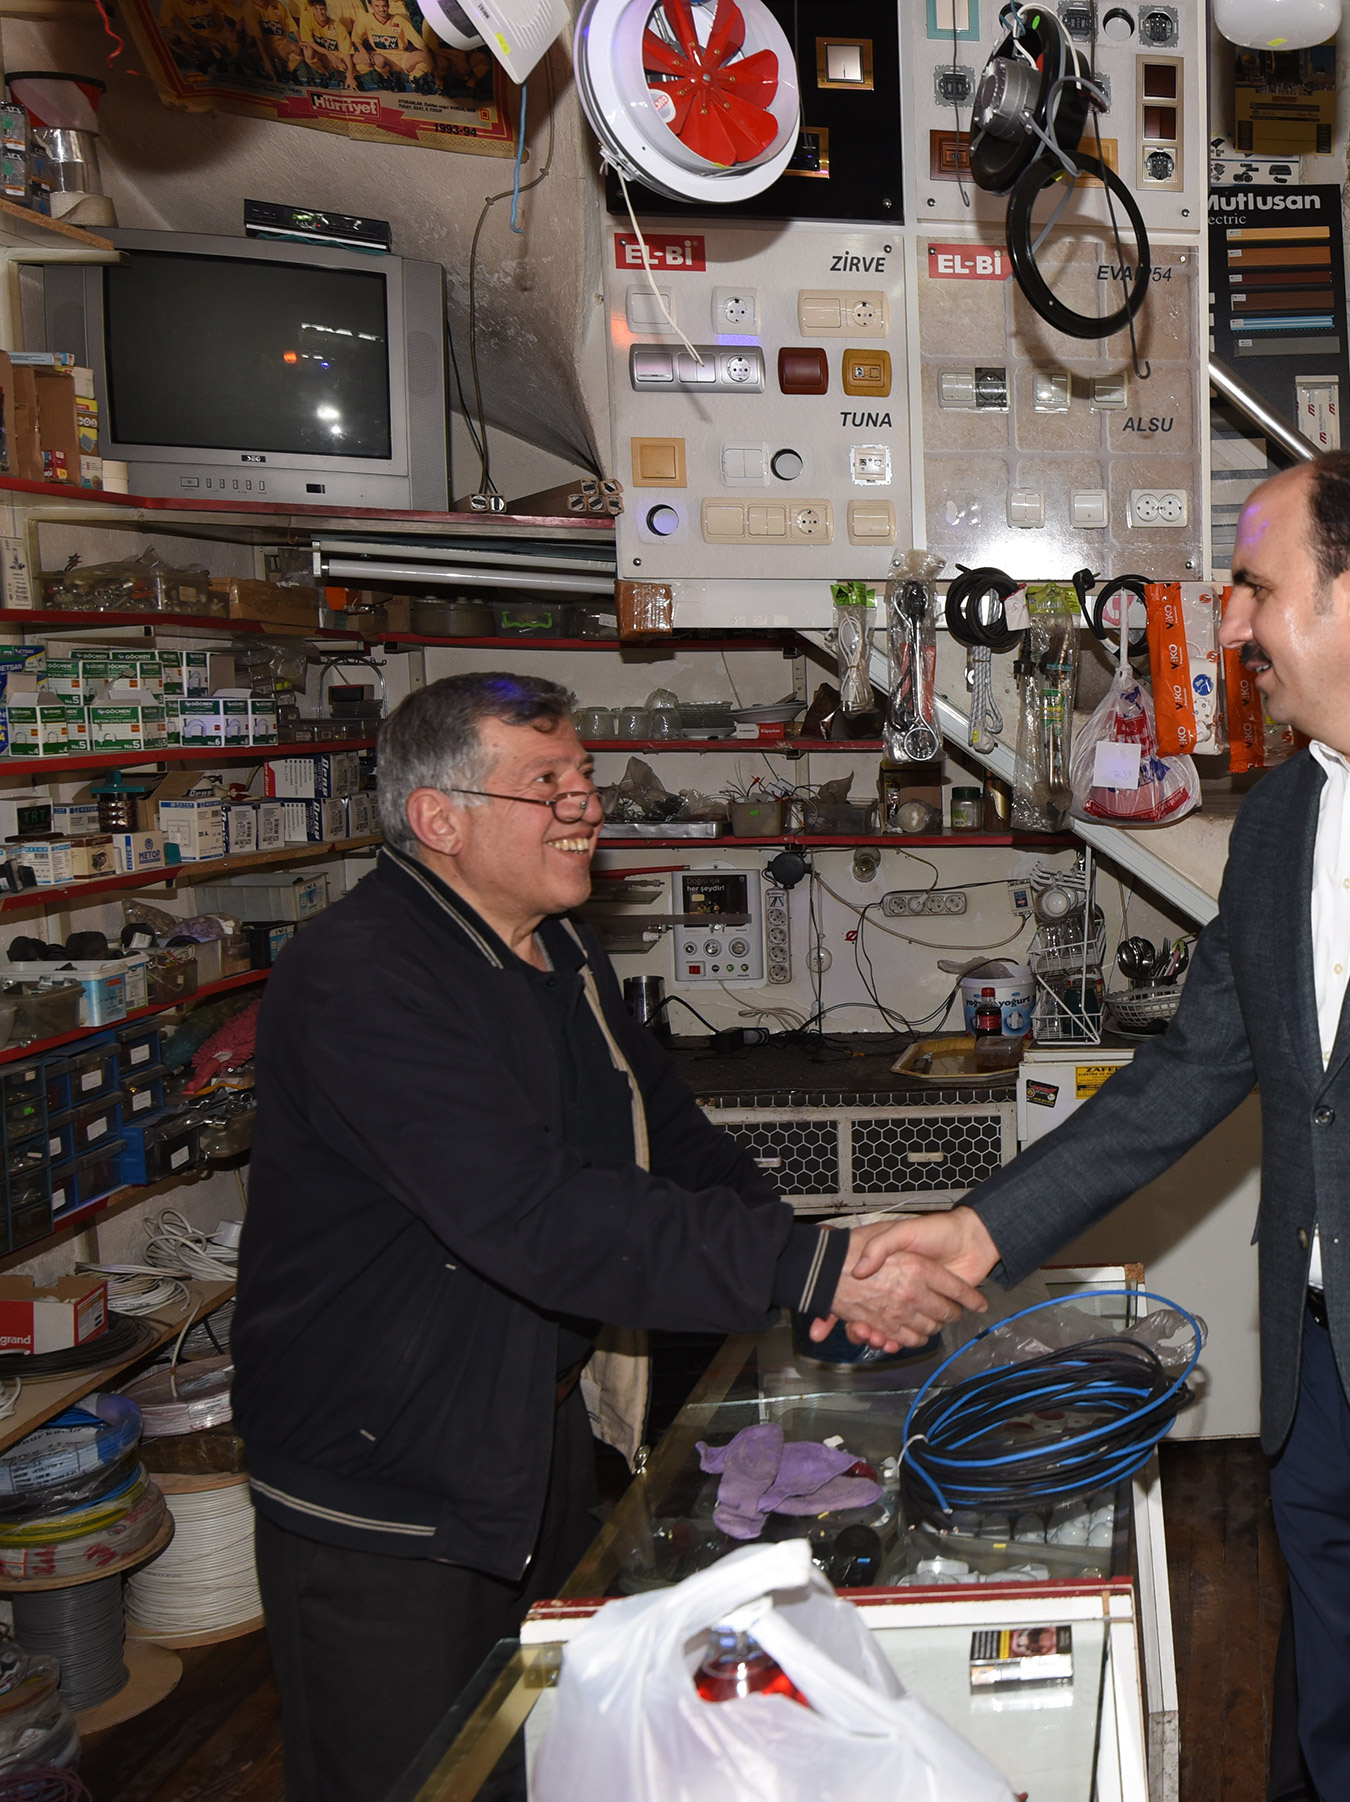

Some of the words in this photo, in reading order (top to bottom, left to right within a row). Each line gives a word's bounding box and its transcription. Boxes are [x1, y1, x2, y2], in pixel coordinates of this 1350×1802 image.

[311, 91, 379, 116] Hürriyet
[433, 122, 478, 137] 1993-94
[1208, 212, 1247, 225] ectric
[829, 250, 887, 273] ZİRVE
[840, 411, 893, 428] TUNA
[1122, 417, 1174, 433] ALSU
[138, 850, 161, 860] METOP
[0, 1334, 31, 1346] grand
